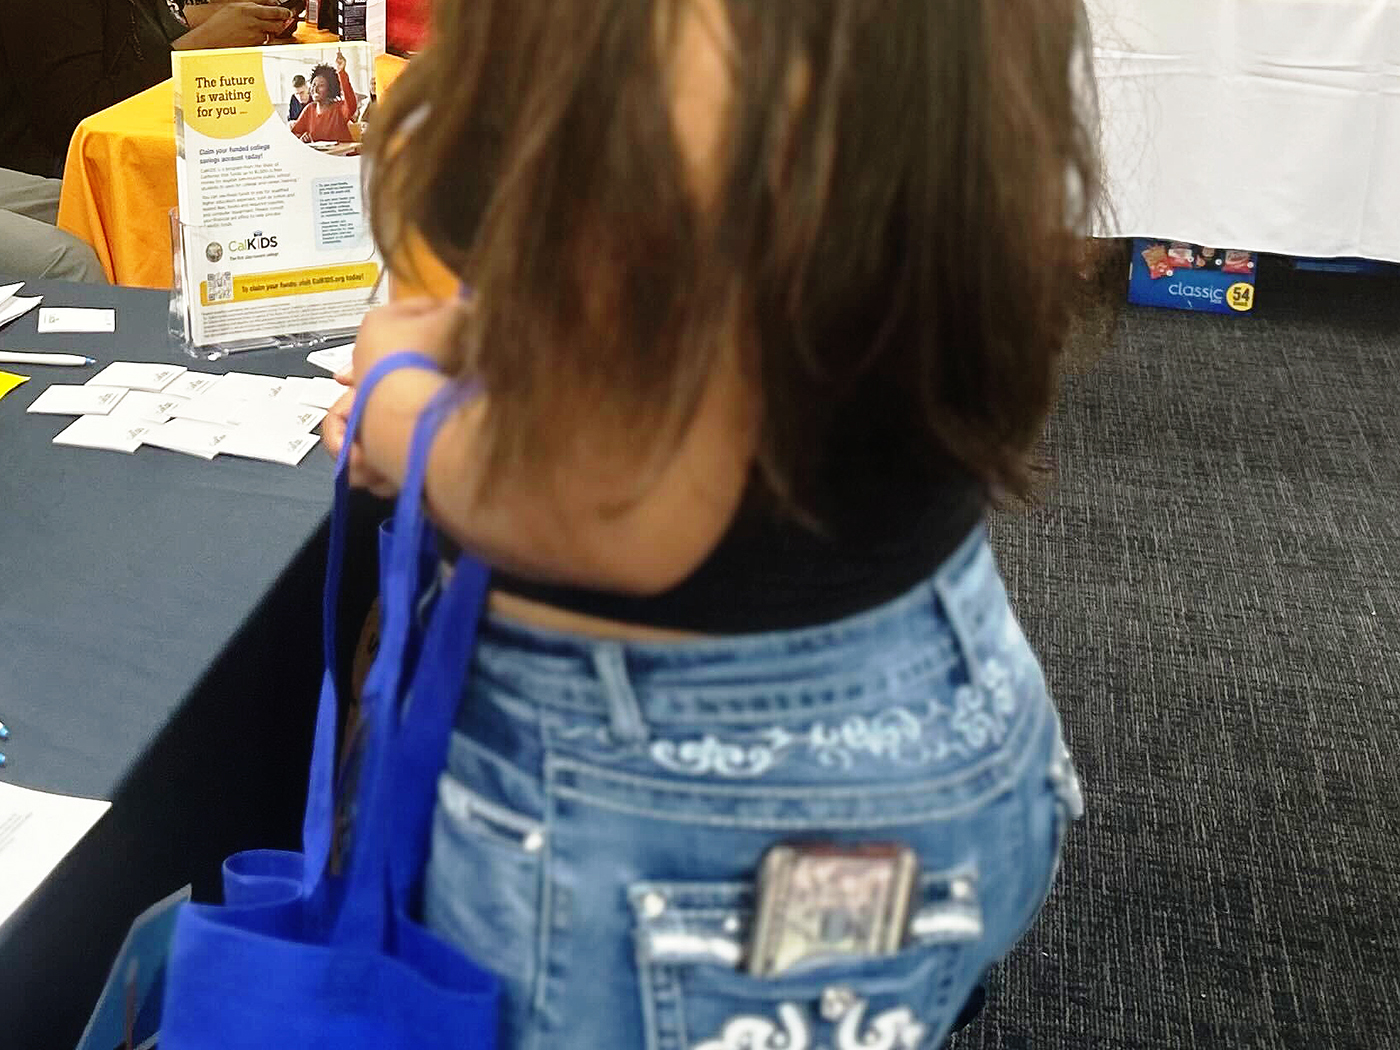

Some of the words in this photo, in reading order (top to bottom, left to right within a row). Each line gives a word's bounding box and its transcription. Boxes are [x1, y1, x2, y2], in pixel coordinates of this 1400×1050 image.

[195, 77, 216, 88] The
[220, 76, 255, 87] future
[196, 92, 206, 103] is
[208, 90, 251, 102] waiting
[197, 106, 213, 117] for
[216, 107, 237, 119] you
[228, 236, 278, 252] CalKIDS
[1168, 281, 1224, 300] classic
[1232, 286, 1250, 302] 54
